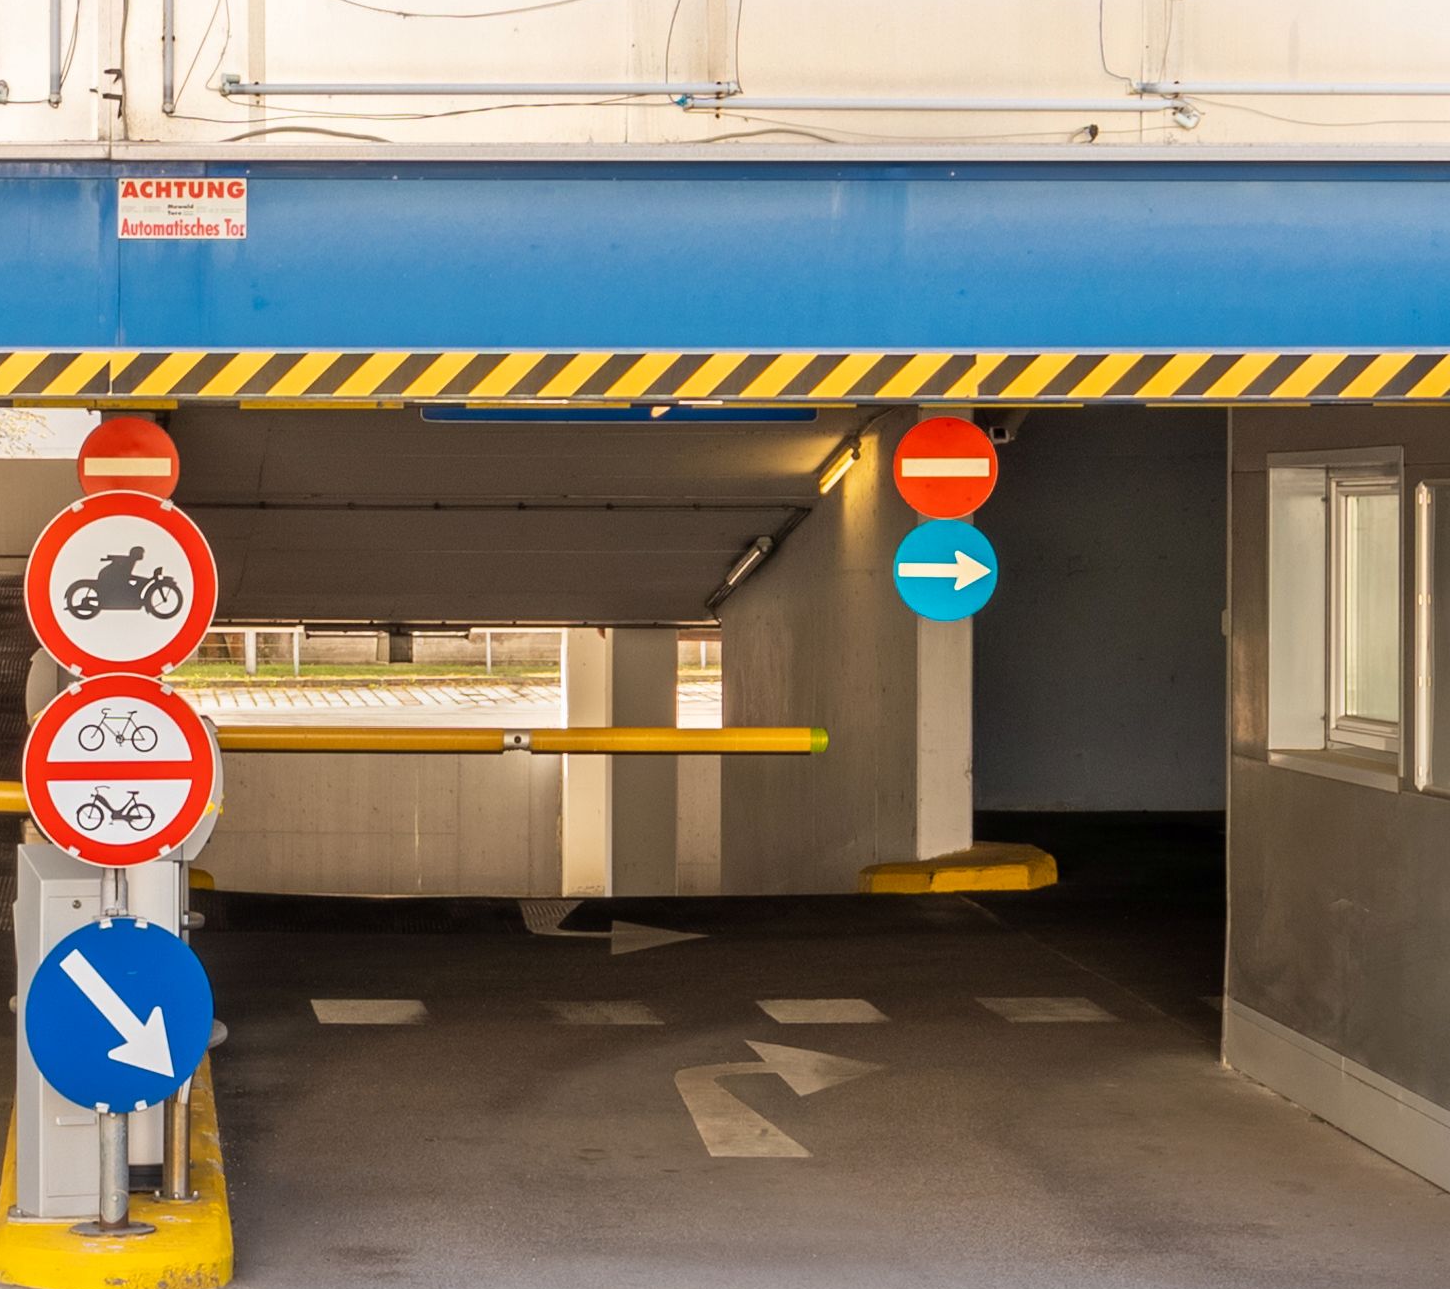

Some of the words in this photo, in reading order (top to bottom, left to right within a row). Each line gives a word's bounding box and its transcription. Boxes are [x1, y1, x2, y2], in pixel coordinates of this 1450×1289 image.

[121, 181, 246, 199] ACHTUNG
[121, 217, 220, 236] Automatisches
[224, 218, 246, 236] Tor
